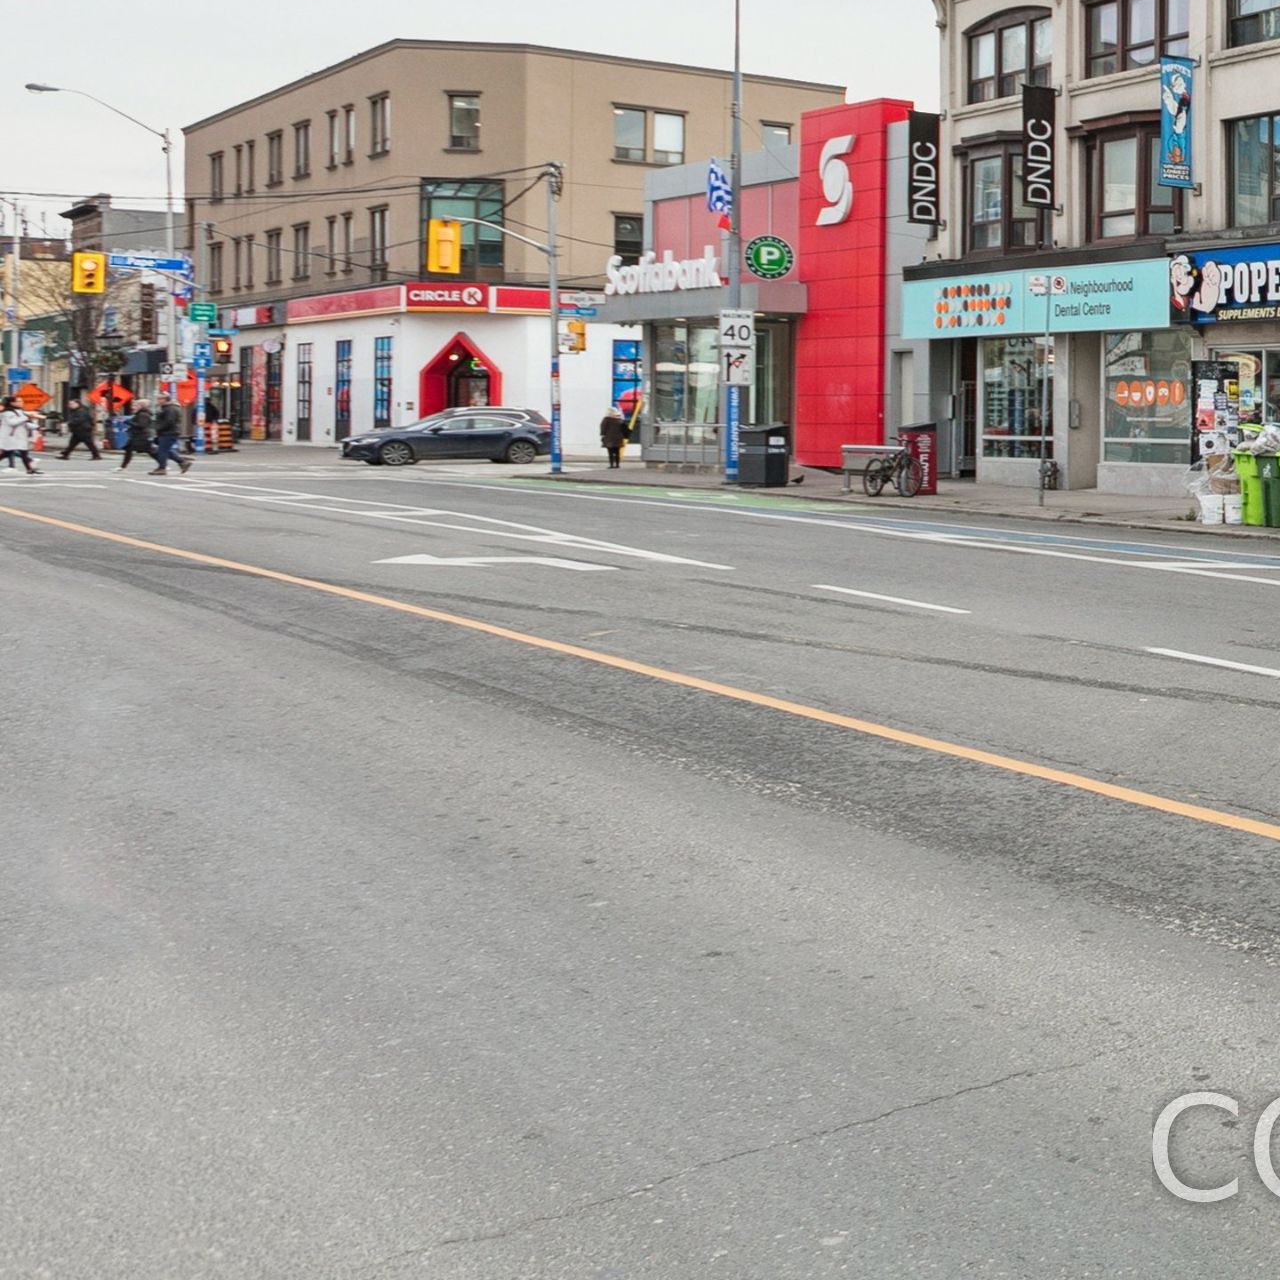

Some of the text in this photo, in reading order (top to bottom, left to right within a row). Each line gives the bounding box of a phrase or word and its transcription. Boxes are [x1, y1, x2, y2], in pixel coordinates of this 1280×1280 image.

[1027, 119, 1051, 204] DNDC
[912, 141, 937, 220] DNDC
[760, 247, 781, 264] P
[604, 245, 723, 295] Scotiabank
[1070, 278, 1133, 296] Neighbourhood
[409, 289, 481, 304] CIRCLE K
[1055, 302, 1111, 318] Dental Centre
[1218, 306, 1275, 320] SUPPLEMENTS
[723, 324, 751, 341] 40
